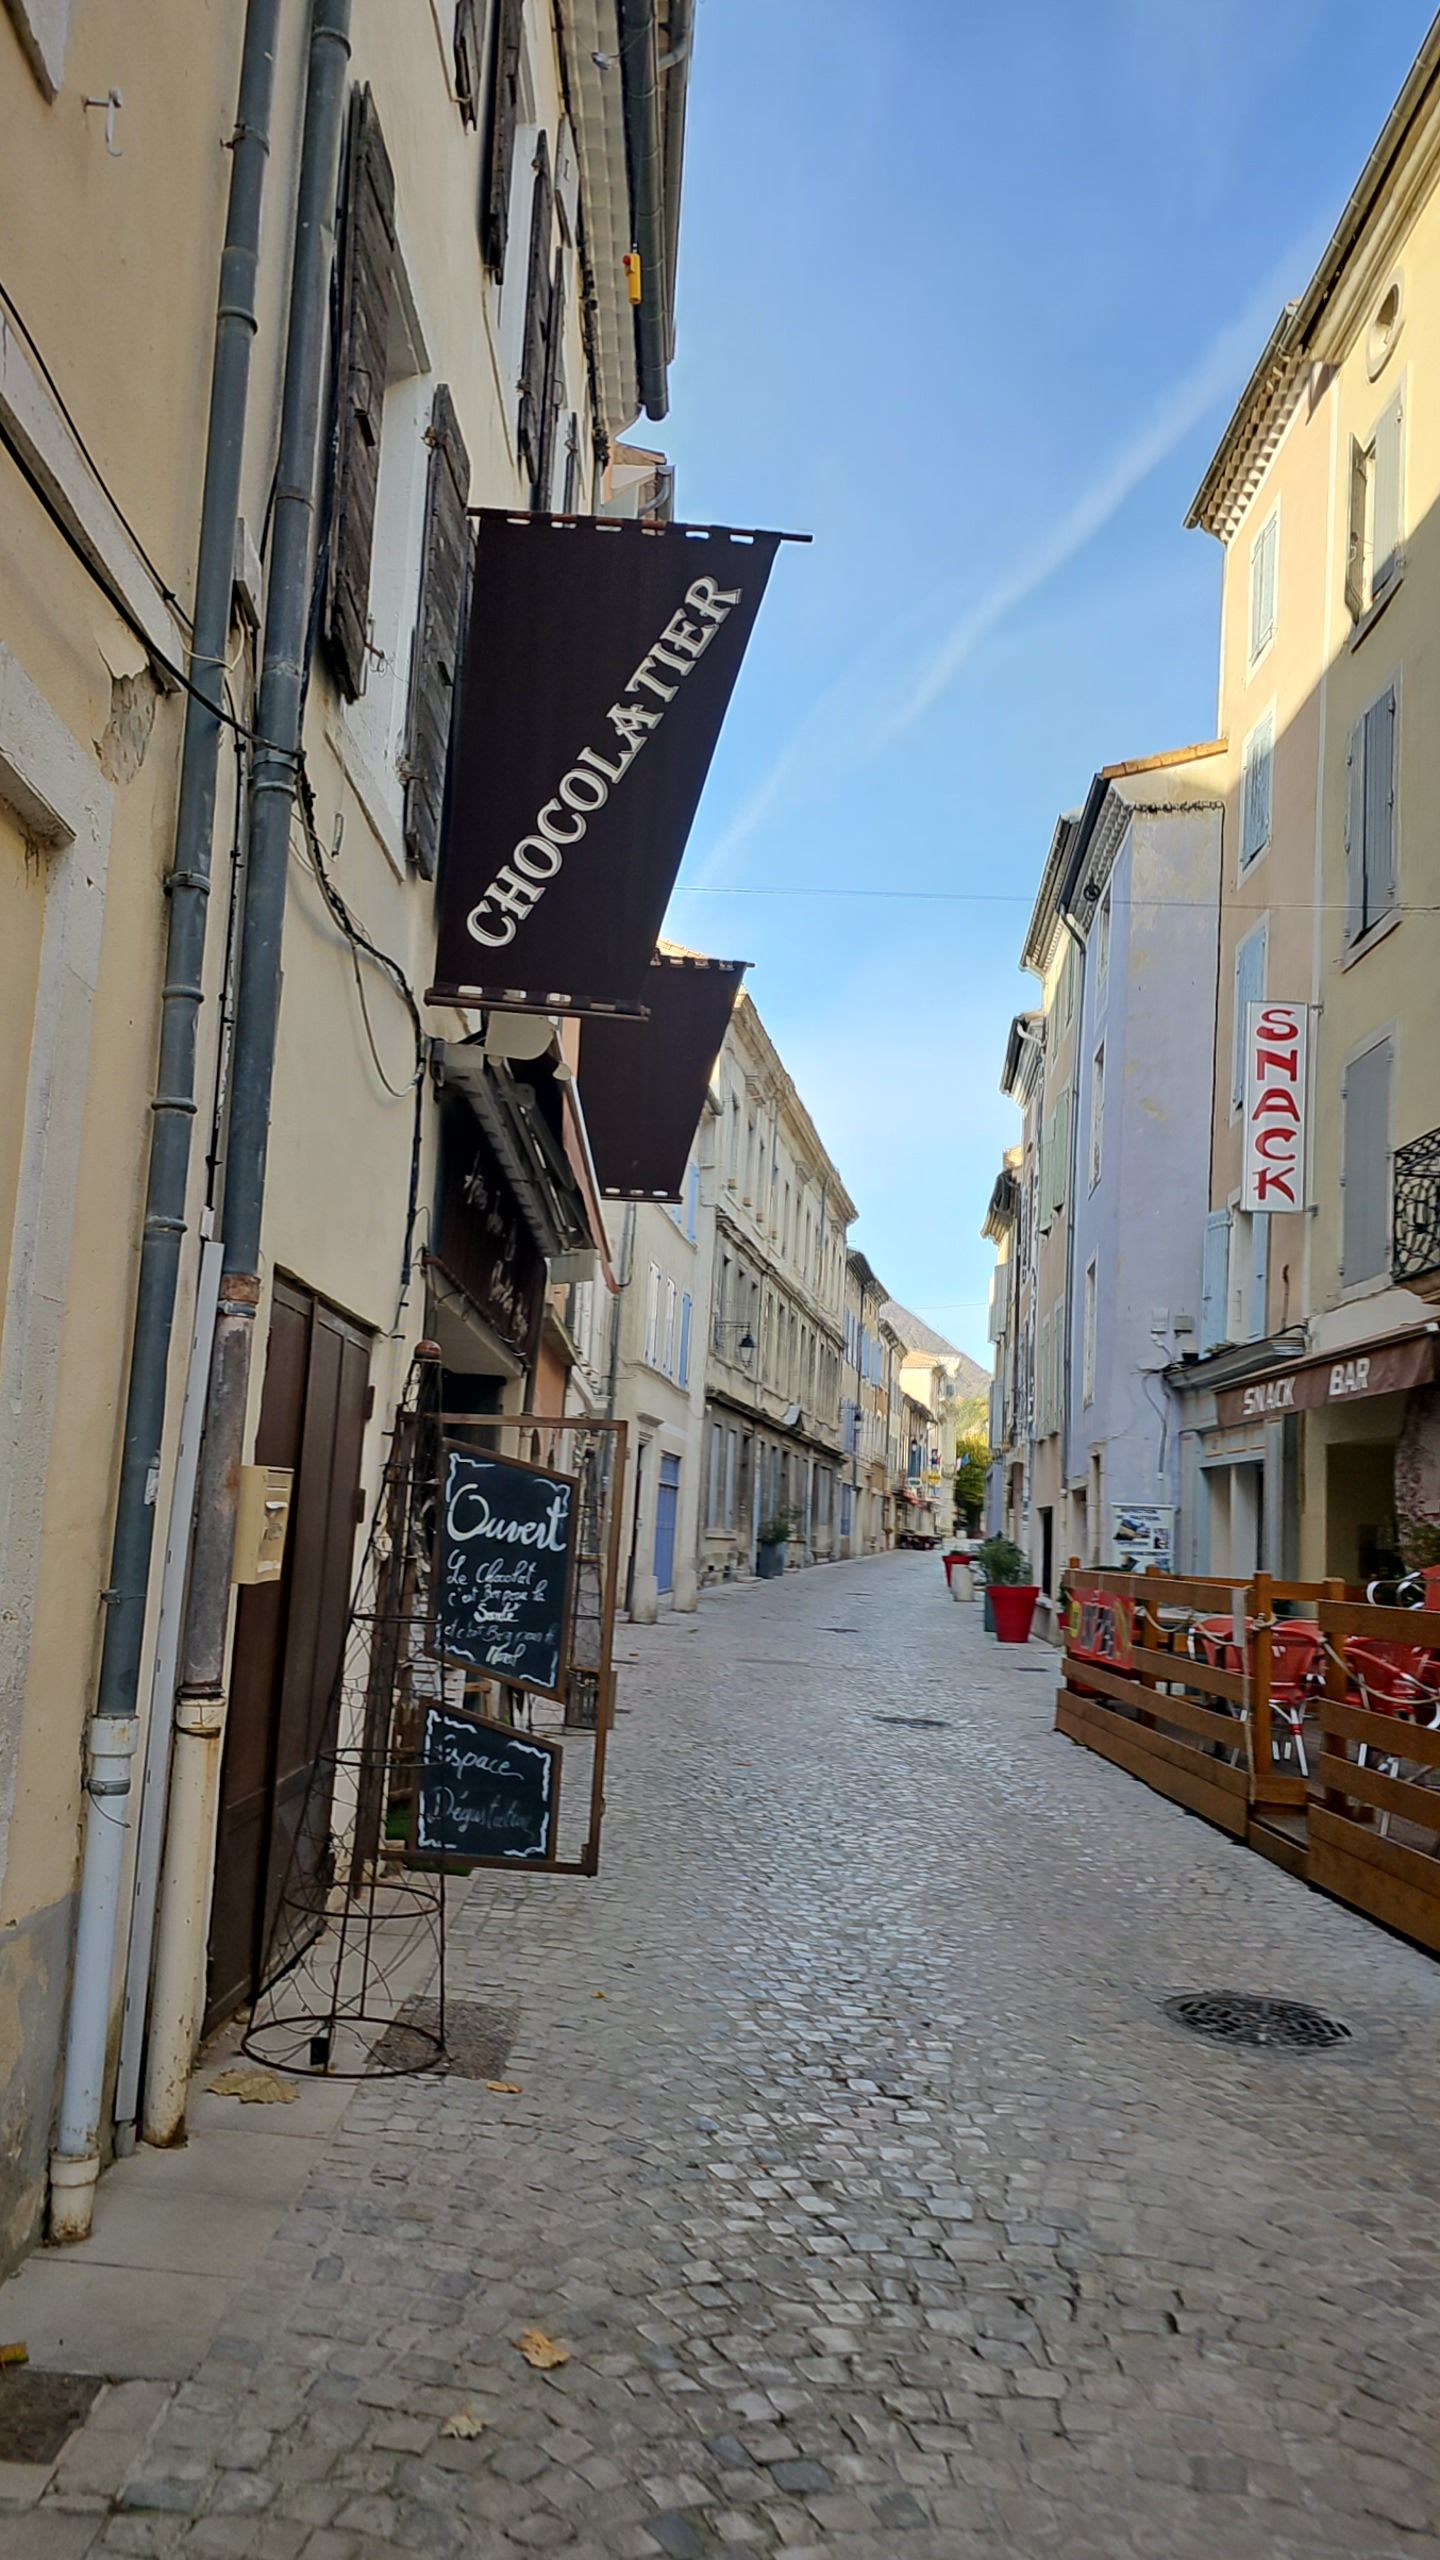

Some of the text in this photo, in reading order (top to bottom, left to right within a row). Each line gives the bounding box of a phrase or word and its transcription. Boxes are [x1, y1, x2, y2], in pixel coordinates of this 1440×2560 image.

[465, 575, 744, 948] CHOCOLATIER
[1251, 1007, 1302, 1206] SNACK
[1243, 1357, 1371, 1415] SNACK BAR
[446, 1482, 568, 1552] Ouvert
[475, 1558, 537, 1585] Chocolat
[434, 1734, 525, 1780] Espace
